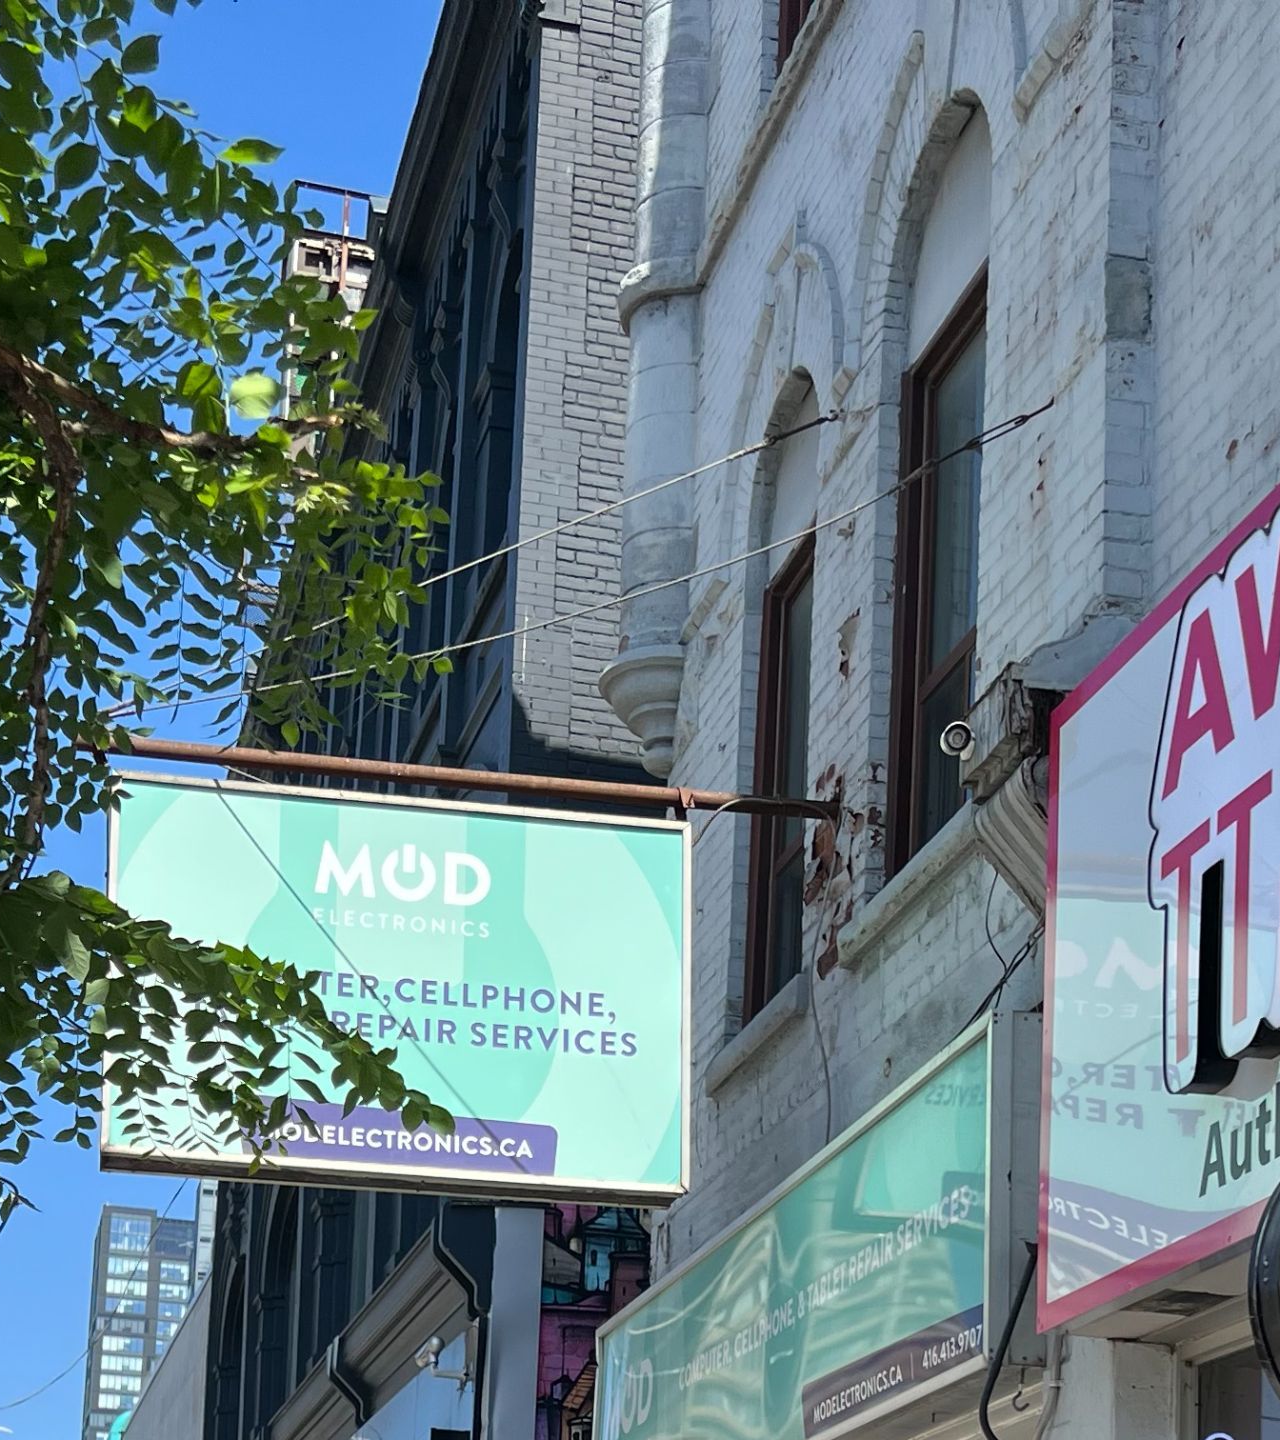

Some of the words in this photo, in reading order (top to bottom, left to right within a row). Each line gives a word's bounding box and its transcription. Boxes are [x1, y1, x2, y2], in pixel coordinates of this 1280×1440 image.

[314, 840, 491, 905] MOD
[313, 907, 490, 938] ELECTRONICS
[331, 1011, 456, 1045] REPAIR
[471, 1022, 637, 1058] SERVICES
[269, 1121, 533, 1159] ODELECTRONICS.CA
[797, 1298, 805, 1319] &
[807, 1262, 848, 1313] TABLET
[848, 1235, 893, 1283] REPAIR
[897, 1186, 971, 1257] SERVICES
[813, 1364, 903, 1424] MODELECTRONICS.CA
[922, 1323, 983, 1370] 416.413.9707
